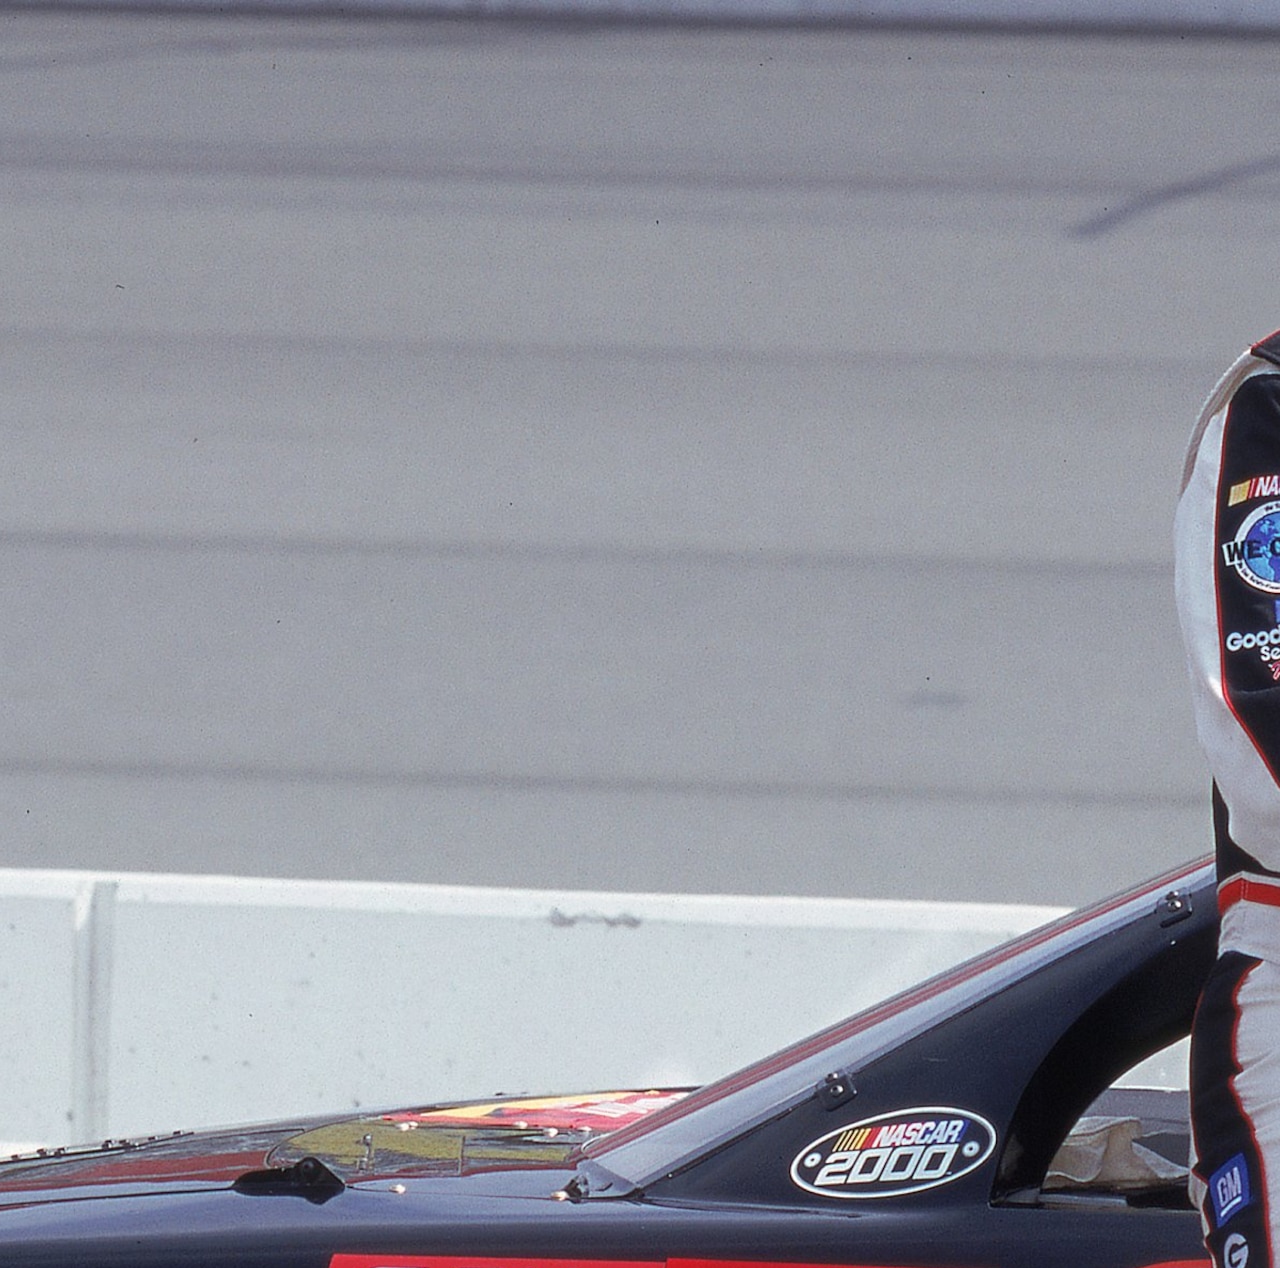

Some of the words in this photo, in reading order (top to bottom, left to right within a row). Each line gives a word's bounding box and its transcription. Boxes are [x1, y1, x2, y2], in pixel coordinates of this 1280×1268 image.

[1225, 539, 1263, 564] WE
[872, 1119, 964, 1148] NASCAR
[814, 1143, 960, 1187] 2000
[1217, 1165, 1242, 1208] GM
